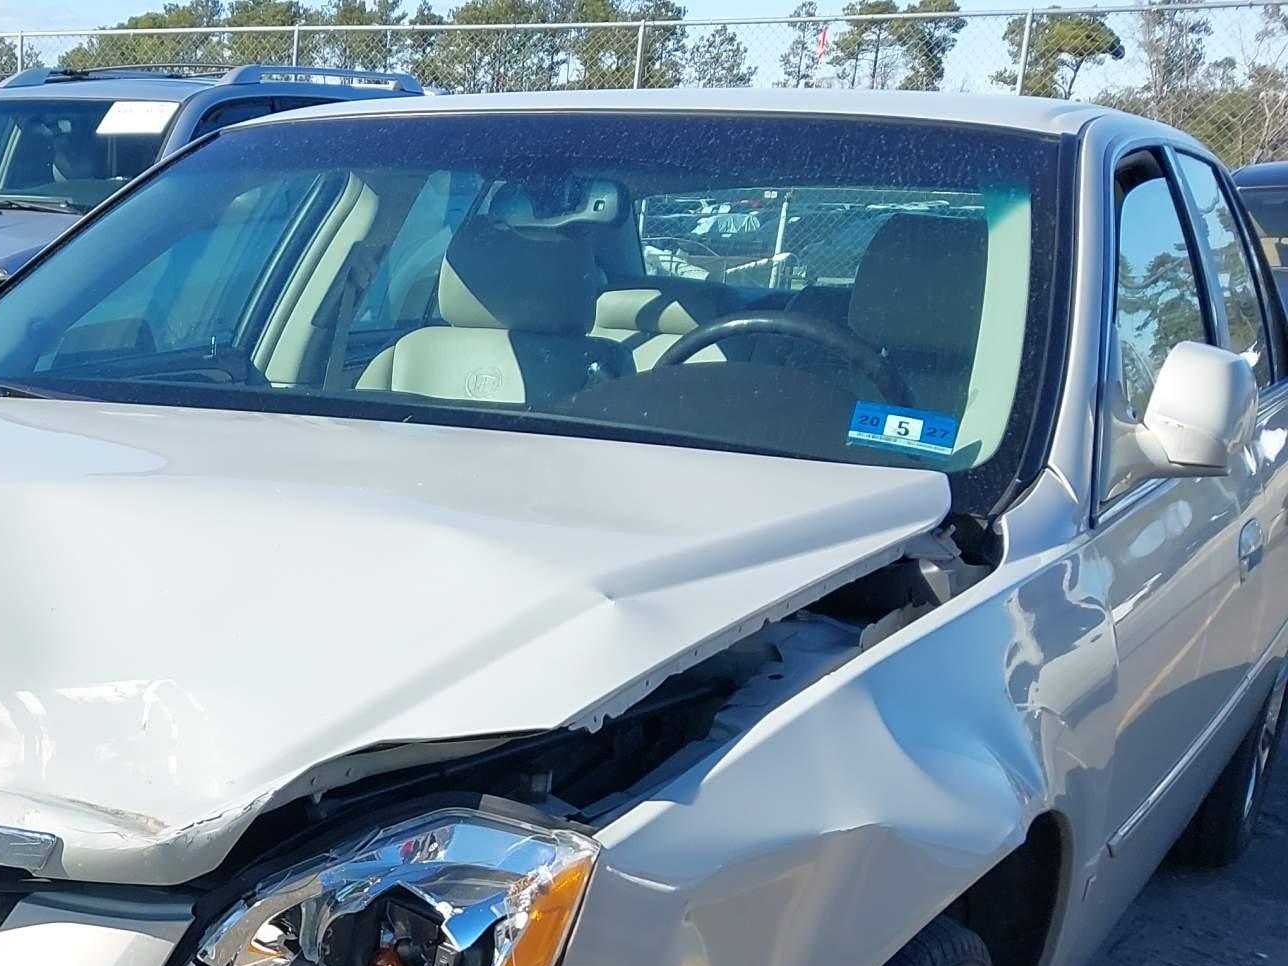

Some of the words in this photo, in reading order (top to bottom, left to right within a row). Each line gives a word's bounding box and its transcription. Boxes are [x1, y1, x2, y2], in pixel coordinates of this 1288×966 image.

[859, 415, 880, 427] 20
[896, 420, 910, 436] 5
[926, 427, 950, 439] 27
